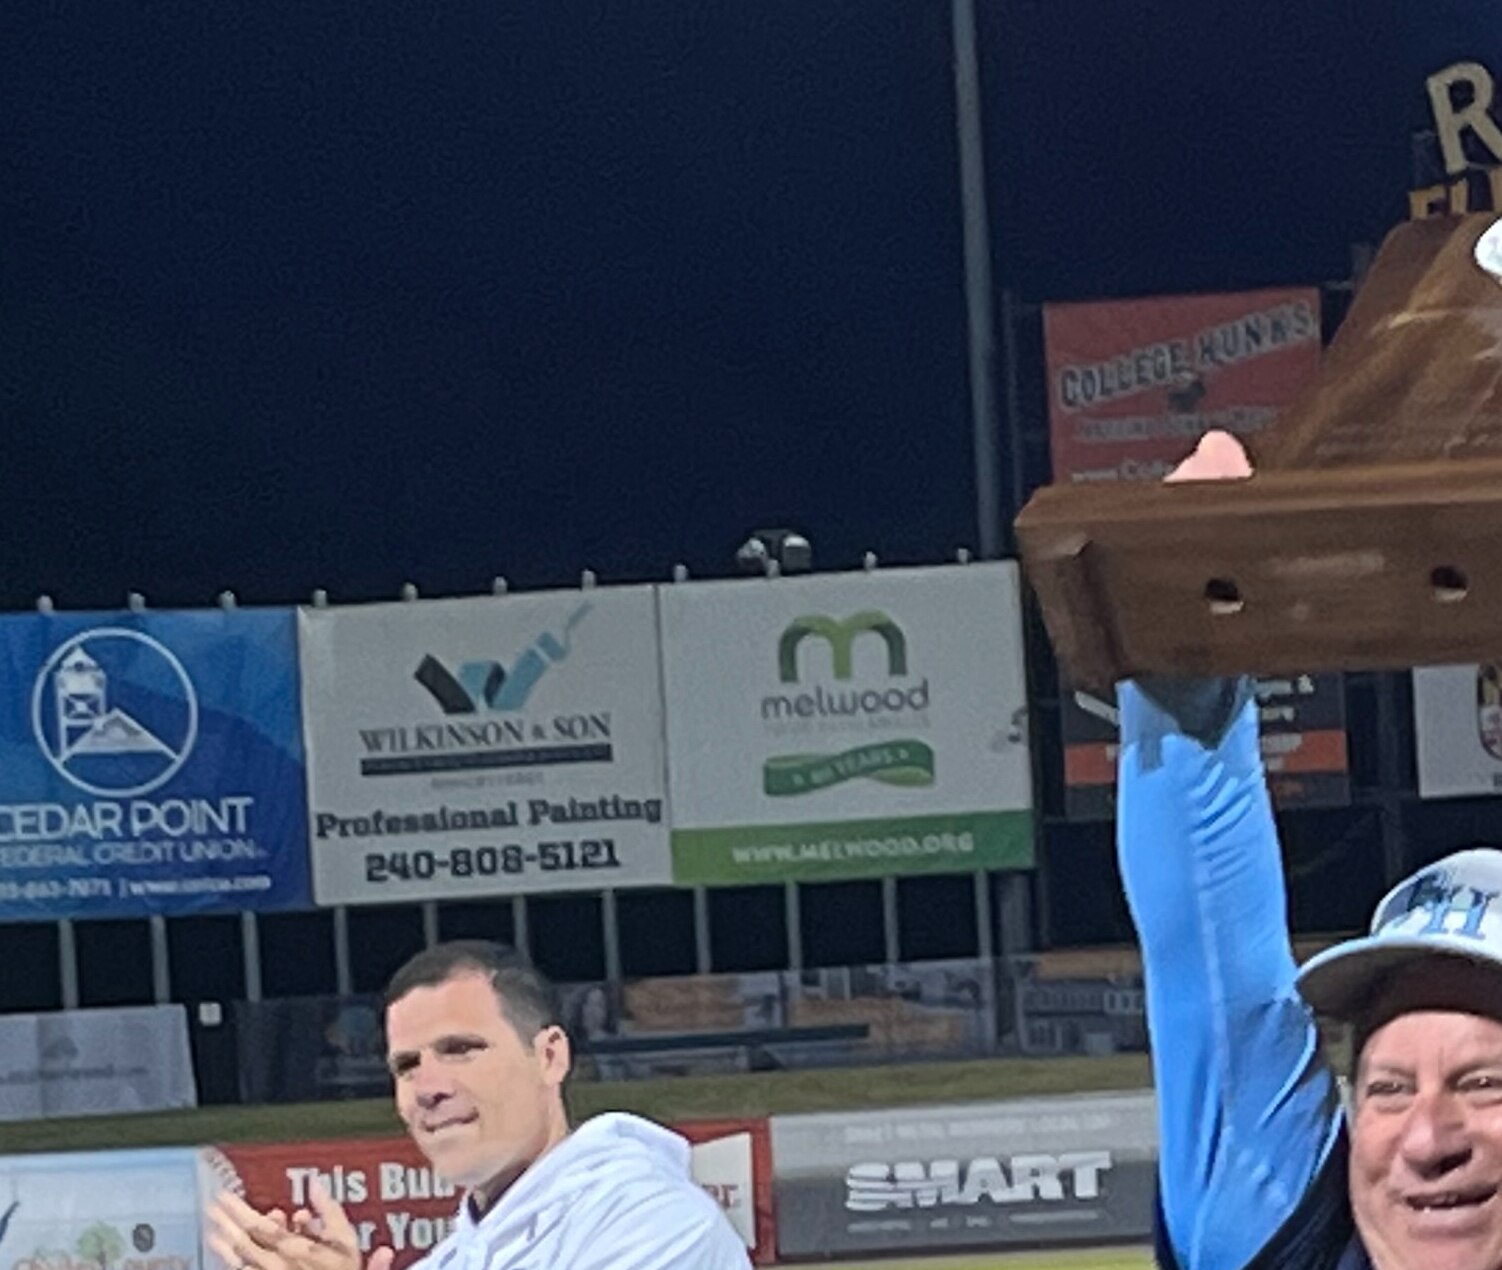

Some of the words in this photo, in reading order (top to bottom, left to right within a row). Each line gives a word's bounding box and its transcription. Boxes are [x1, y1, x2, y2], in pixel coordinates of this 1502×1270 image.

[1060, 341, 1189, 411] COLLEGE
[1194, 301, 1312, 368] HUNKS
[761, 678, 929, 720] melwood
[358, 720, 524, 753] WILKINSON
[553, 712, 612, 740] SON
[130, 796, 254, 837] POINT
[316, 801, 519, 838] Professional
[528, 794, 663, 826] Painting
[0, 843, 92, 868] EDERAL
[93, 840, 177, 864] CREDIT
[366, 838, 622, 883] 240-808-5121
[285, 1164, 368, 1205] This
[845, 1150, 1112, 1211] SMART
